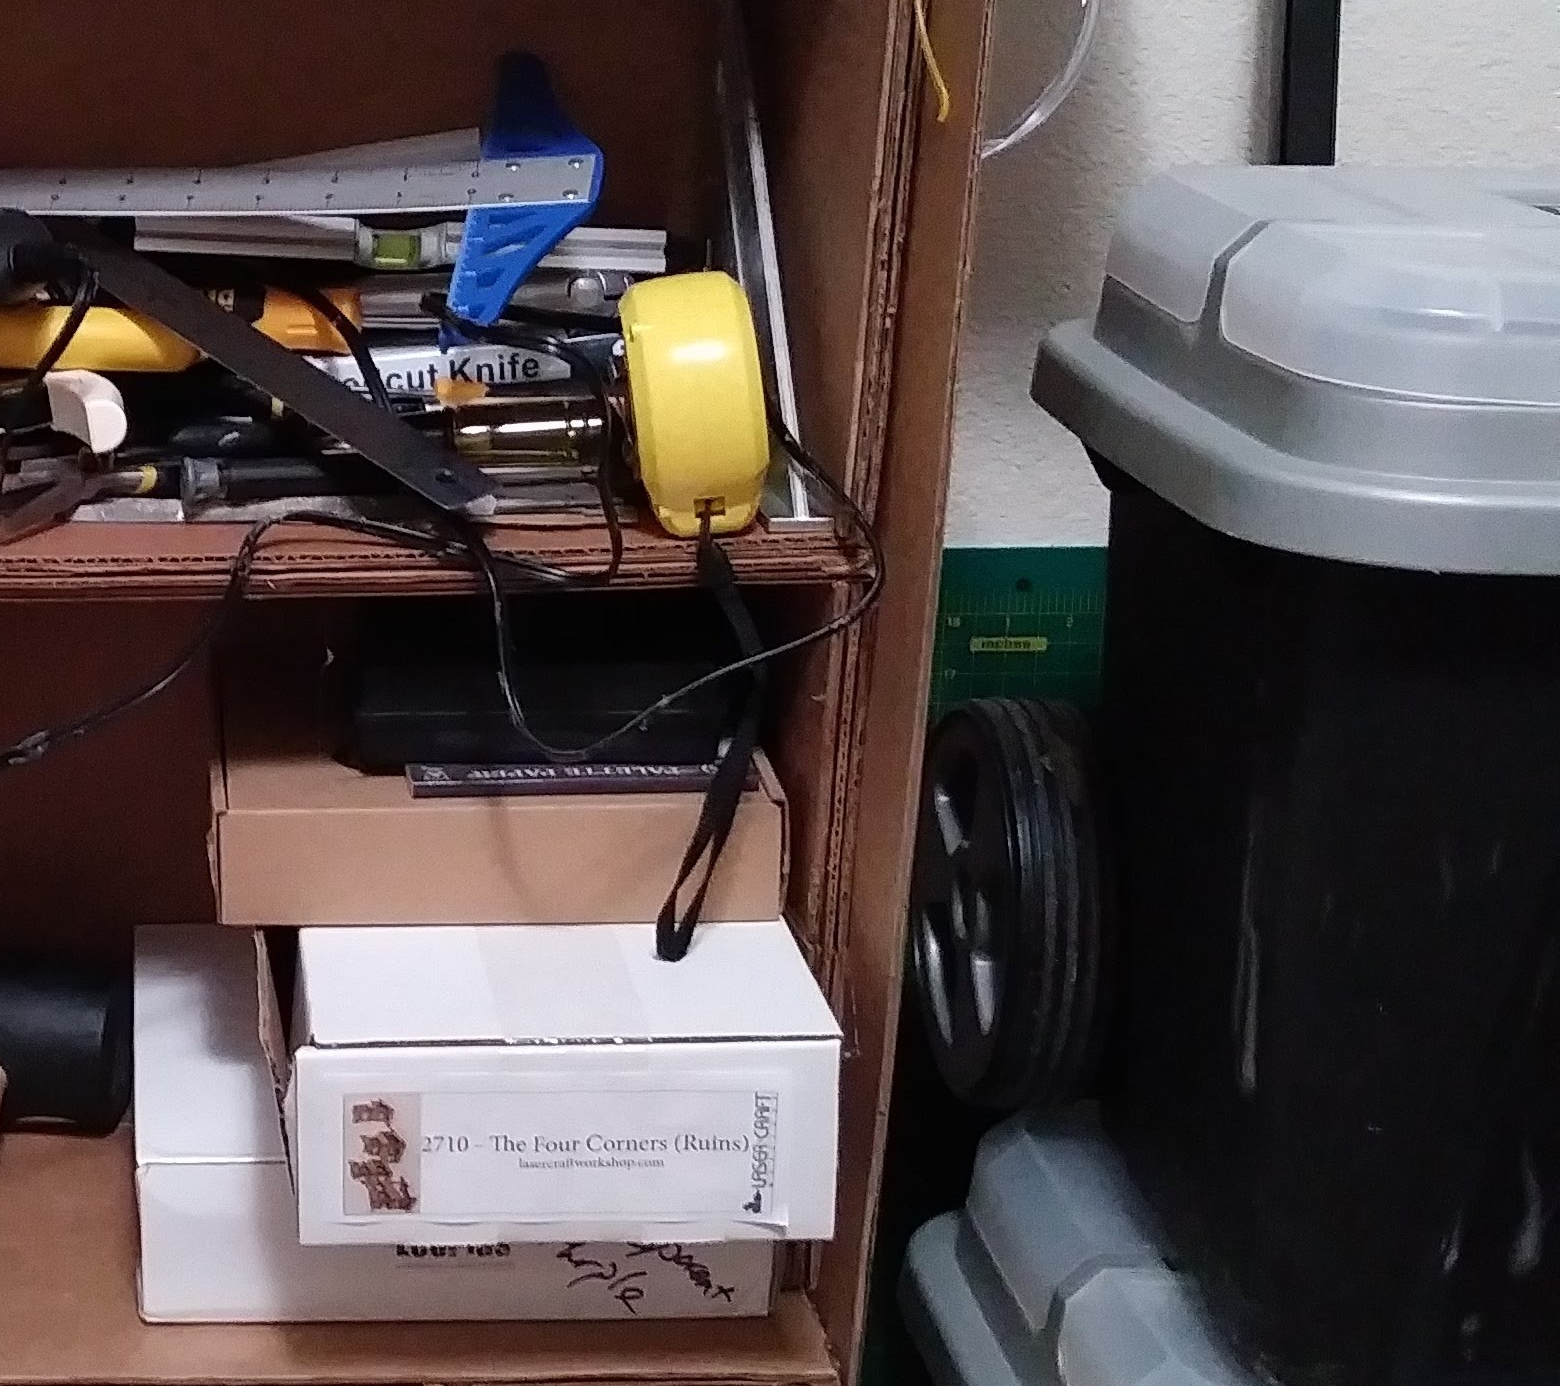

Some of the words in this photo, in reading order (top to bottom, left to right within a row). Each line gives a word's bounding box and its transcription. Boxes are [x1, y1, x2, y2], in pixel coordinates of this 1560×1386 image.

[448, 352, 541, 384] Knife
[422, 1135, 469, 1153] 2710
[489, 1134, 527, 1153] The
[533, 1134, 581, 1153] Four
[586, 1134, 668, 1153] Corners
[673, 1133, 750, 1154] (Ruins)
